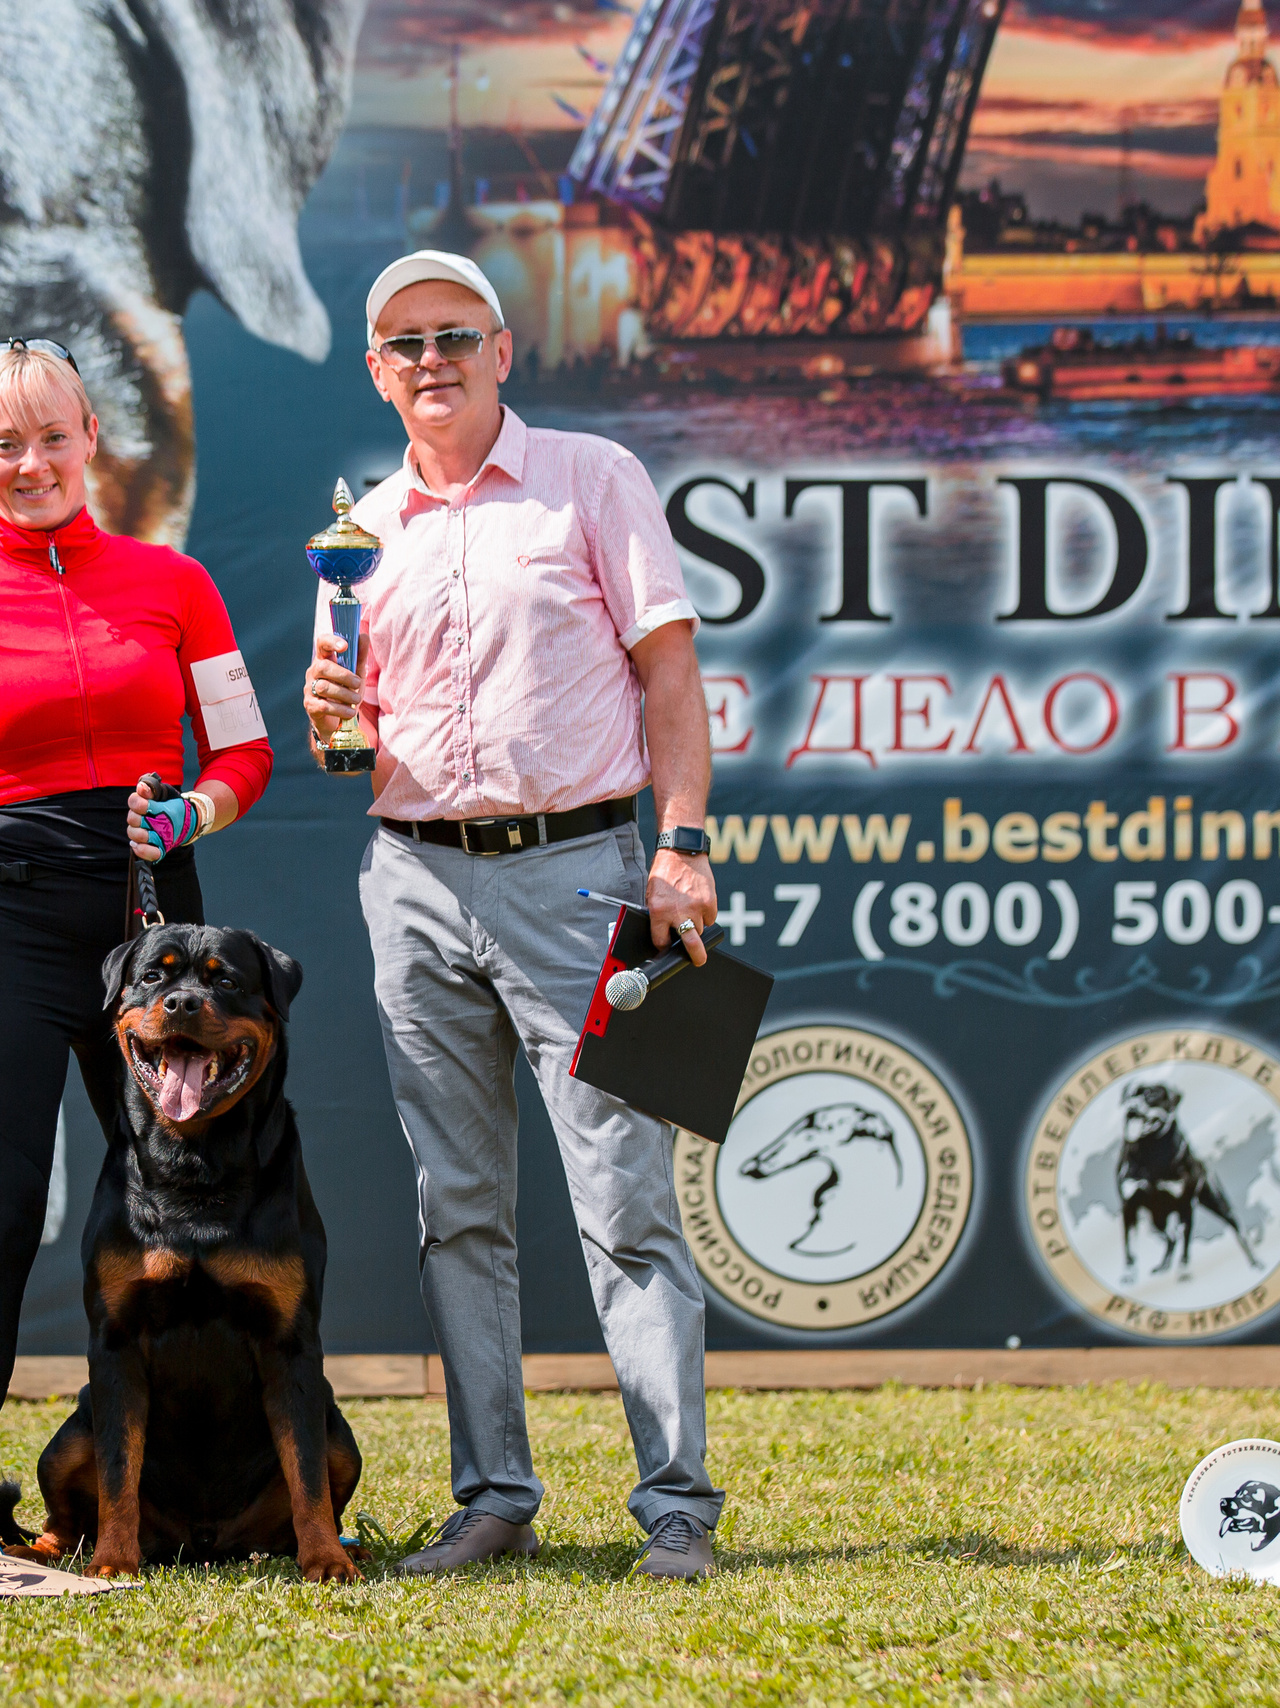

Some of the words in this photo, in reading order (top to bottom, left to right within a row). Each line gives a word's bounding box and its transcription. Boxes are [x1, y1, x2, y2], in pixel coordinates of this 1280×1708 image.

[664, 475, 928, 625] ST
[785, 672, 1120, 770] ДЕЛО
[1166, 672, 1240, 753] В
[717, 882, 822, 947] +7
[851, 880, 1080, 961] (800)
[1173, 1034, 1274, 1087] КЛУБ
[744, 1039, 951, 1138] ОЛОГИЧЕСКАЯ
[859, 1147, 961, 1310] ФЕДЕРАЦИЯ
